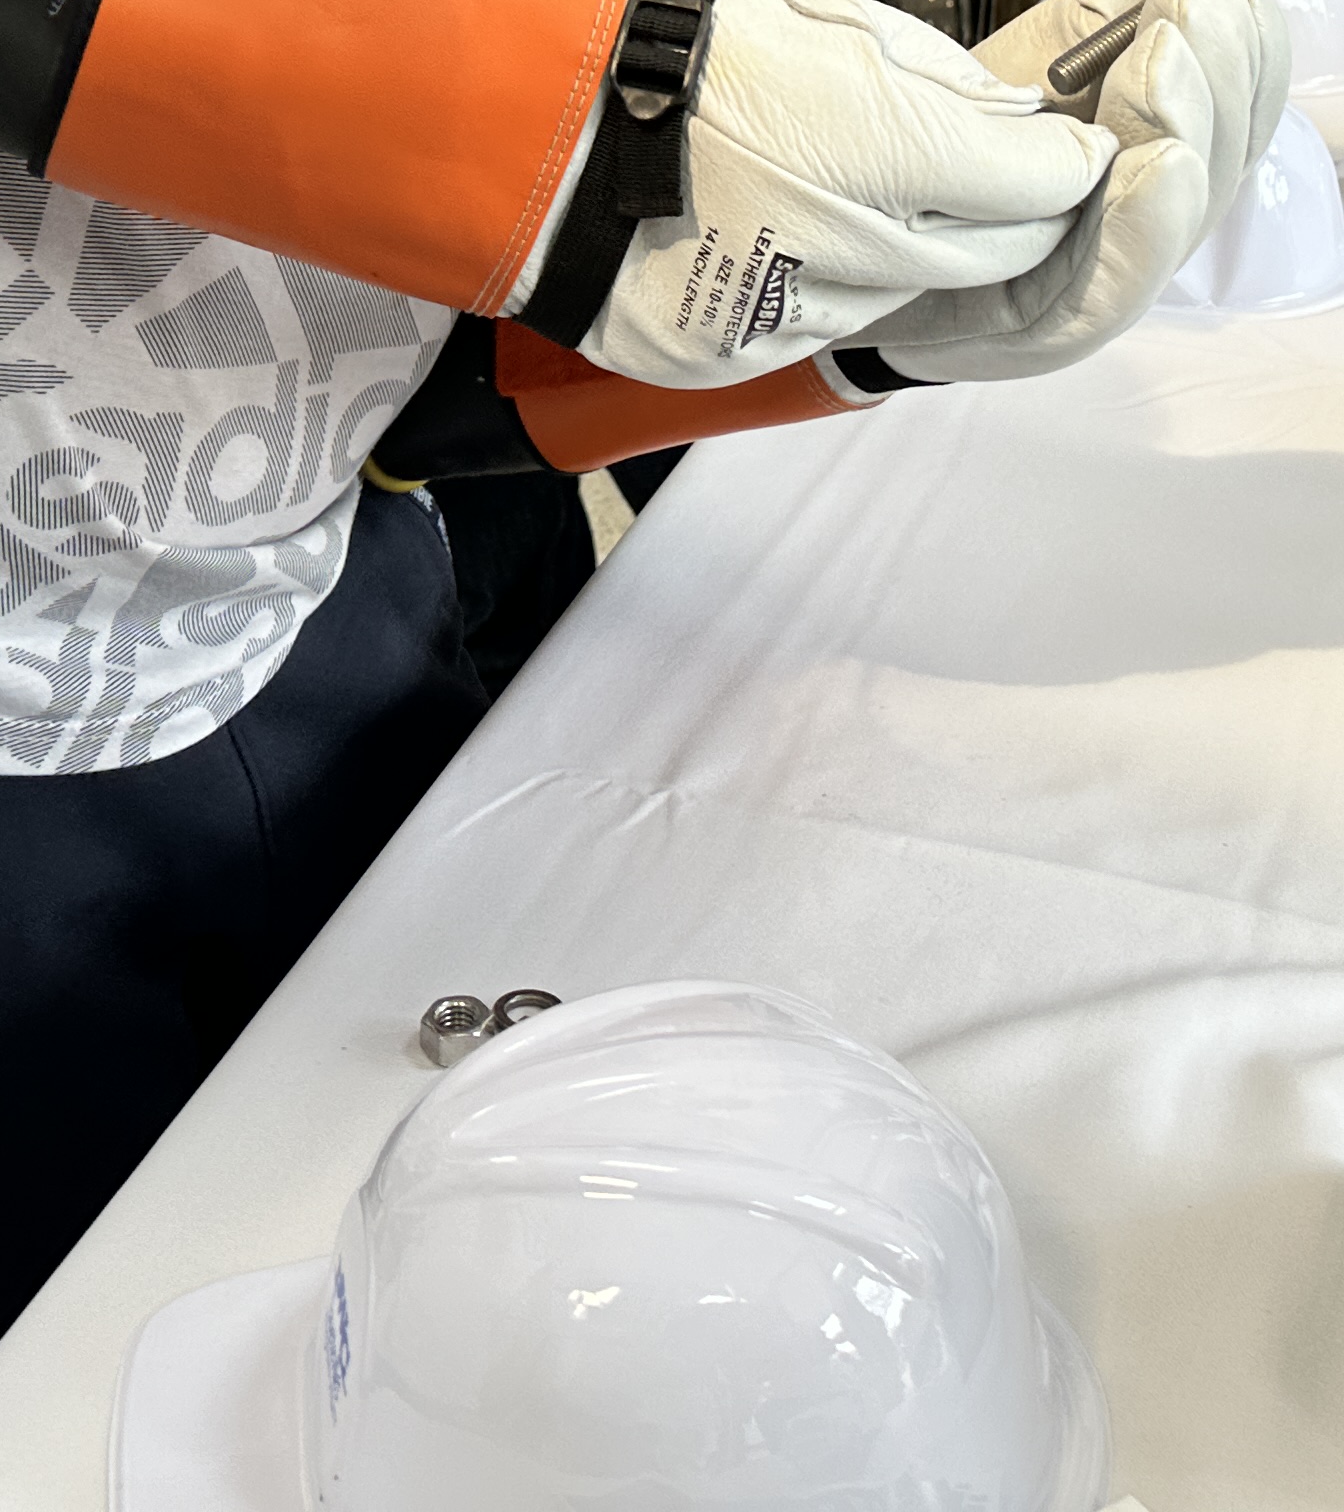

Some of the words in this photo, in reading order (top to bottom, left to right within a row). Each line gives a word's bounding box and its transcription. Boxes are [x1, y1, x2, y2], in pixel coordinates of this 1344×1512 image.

[705, 226, 719, 244] 14
[691, 242, 712, 279] INCH
[715, 255, 734, 286] SIZE
[740, 226, 775, 294] LEATHER
[675, 278, 700, 331] LENGTH
